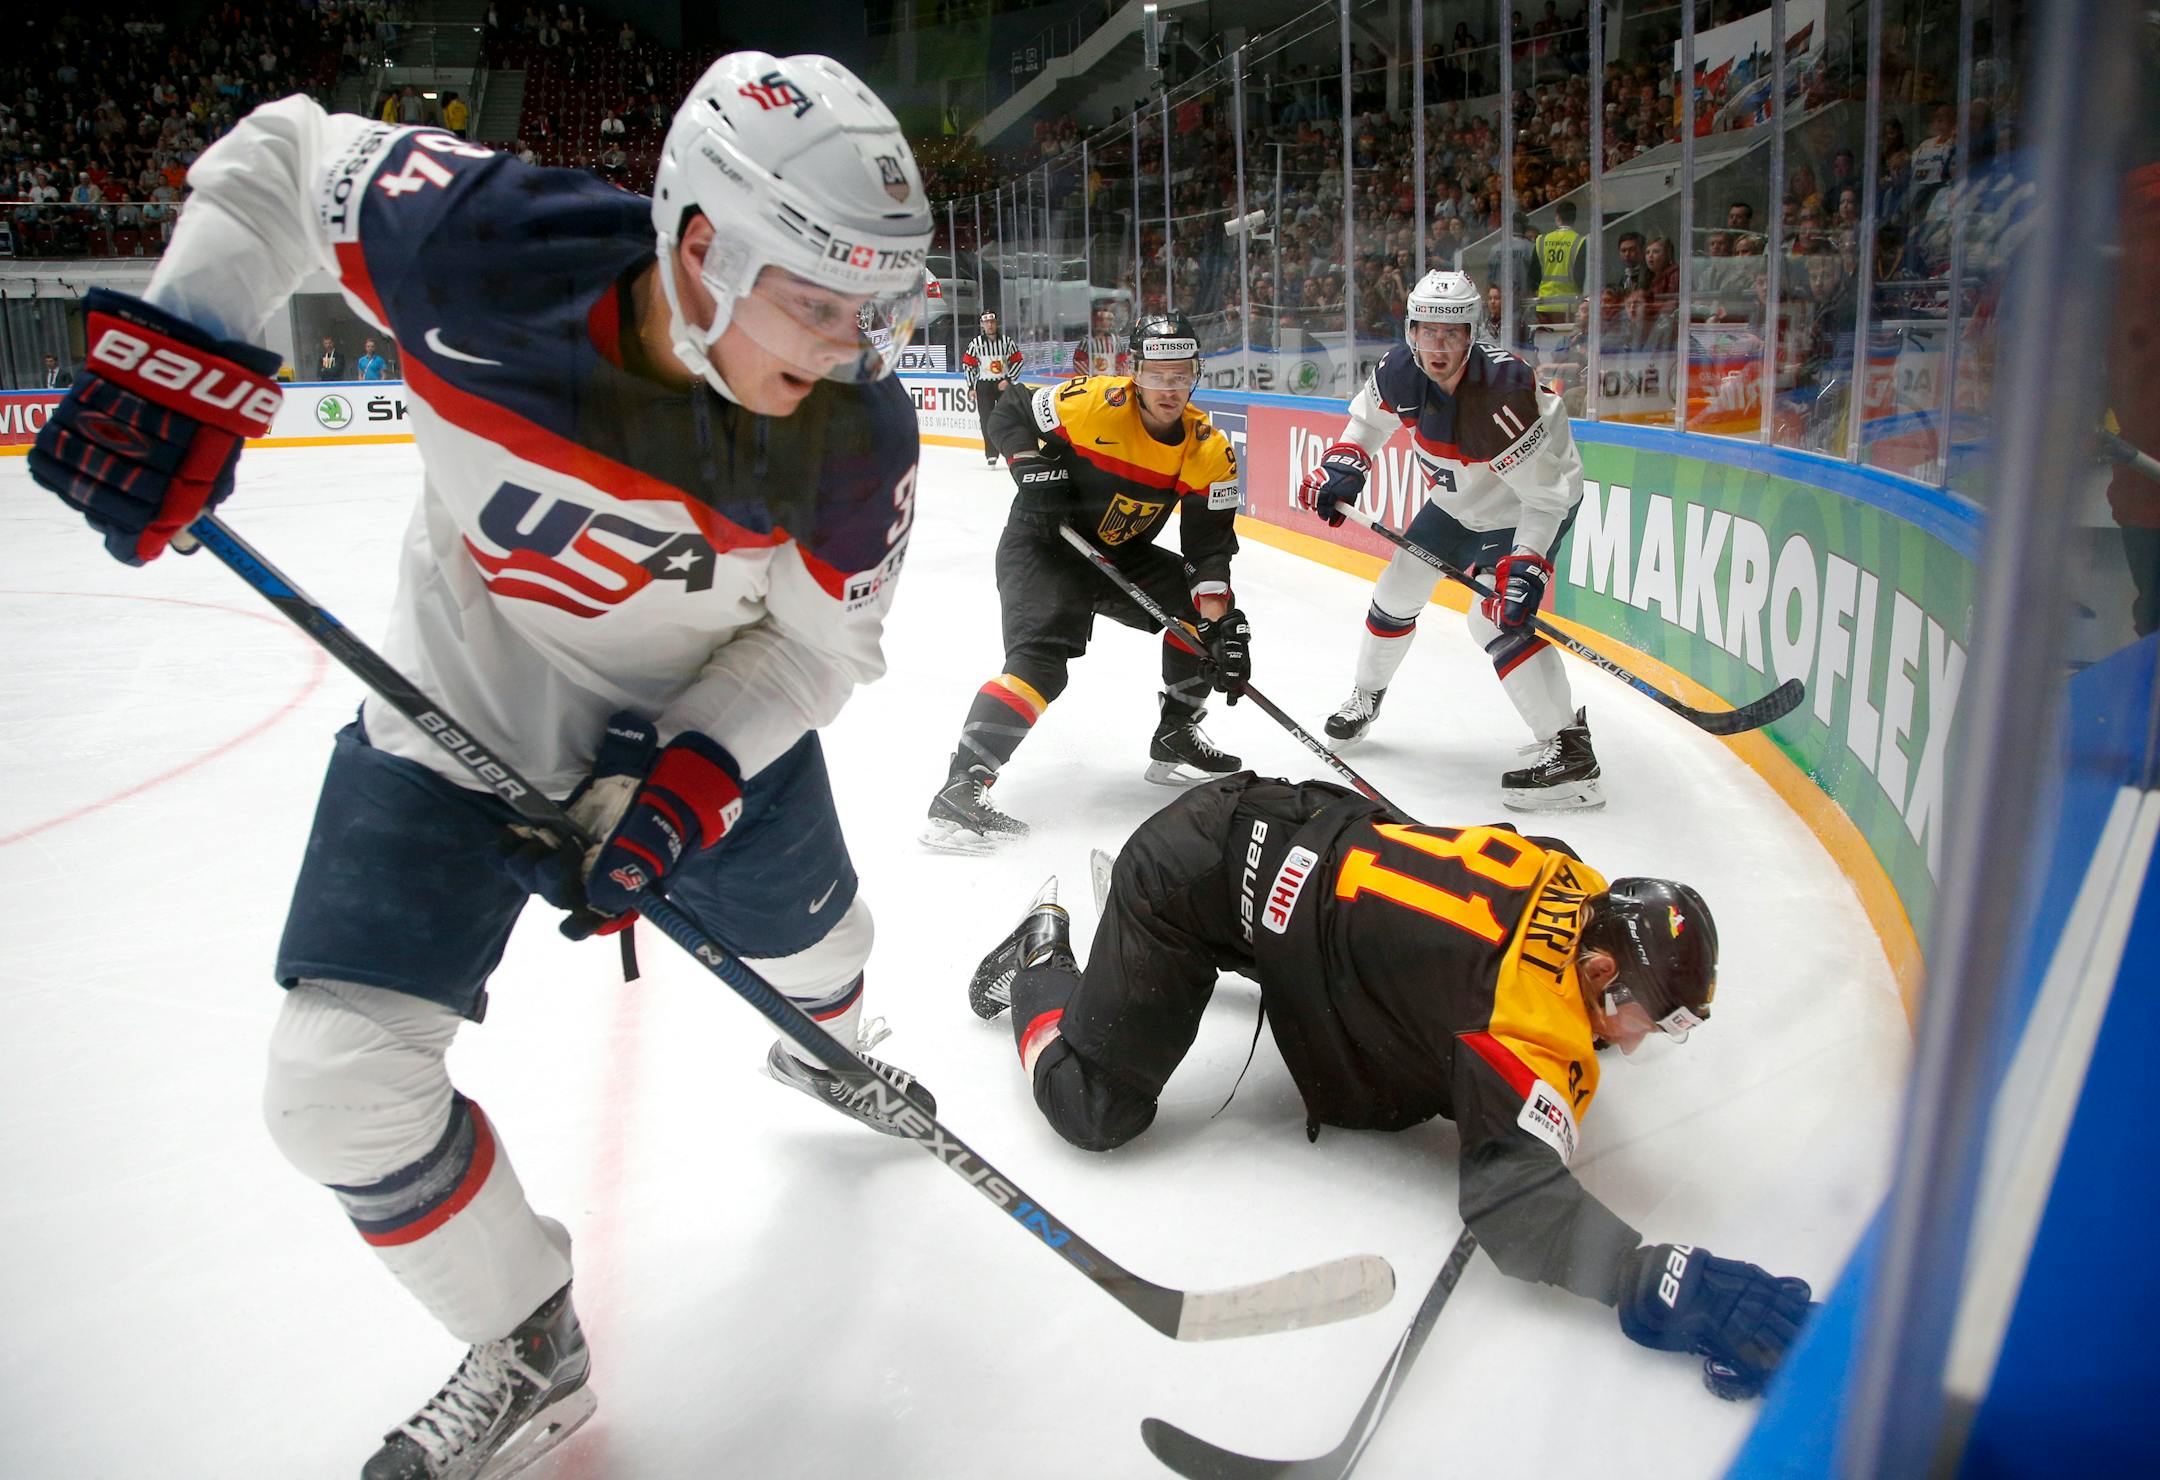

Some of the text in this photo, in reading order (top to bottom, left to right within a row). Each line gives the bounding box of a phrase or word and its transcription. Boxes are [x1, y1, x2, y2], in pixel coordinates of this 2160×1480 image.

[331, 124, 396, 234] ISSOT
[1548, 249, 1564, 264] 30
[1429, 306, 1465, 314] TISSOT
[1159, 342, 1194, 351] TISSOT
[935, 416, 966, 430] WATCHES
[1492, 405, 1524, 440] 11
[1511, 423, 1544, 459] TISSOT
[463, 480, 717, 618] USA
[1407, 545, 1444, 569] BAUER
[1130, 590, 1167, 623] BAUER
[1566, 639, 1634, 683] NEXUS
[1568, 480, 1968, 893] MAKROFLEX
[416, 711, 527, 800] BAUER
[1290, 726, 1355, 781] NEXUS
[1240, 820, 1268, 945] BAUER
[1267, 865, 1304, 927] IIHF
[1528, 1110, 1555, 1133] SWISS
[857, 1079, 1018, 1208] NEXUS
